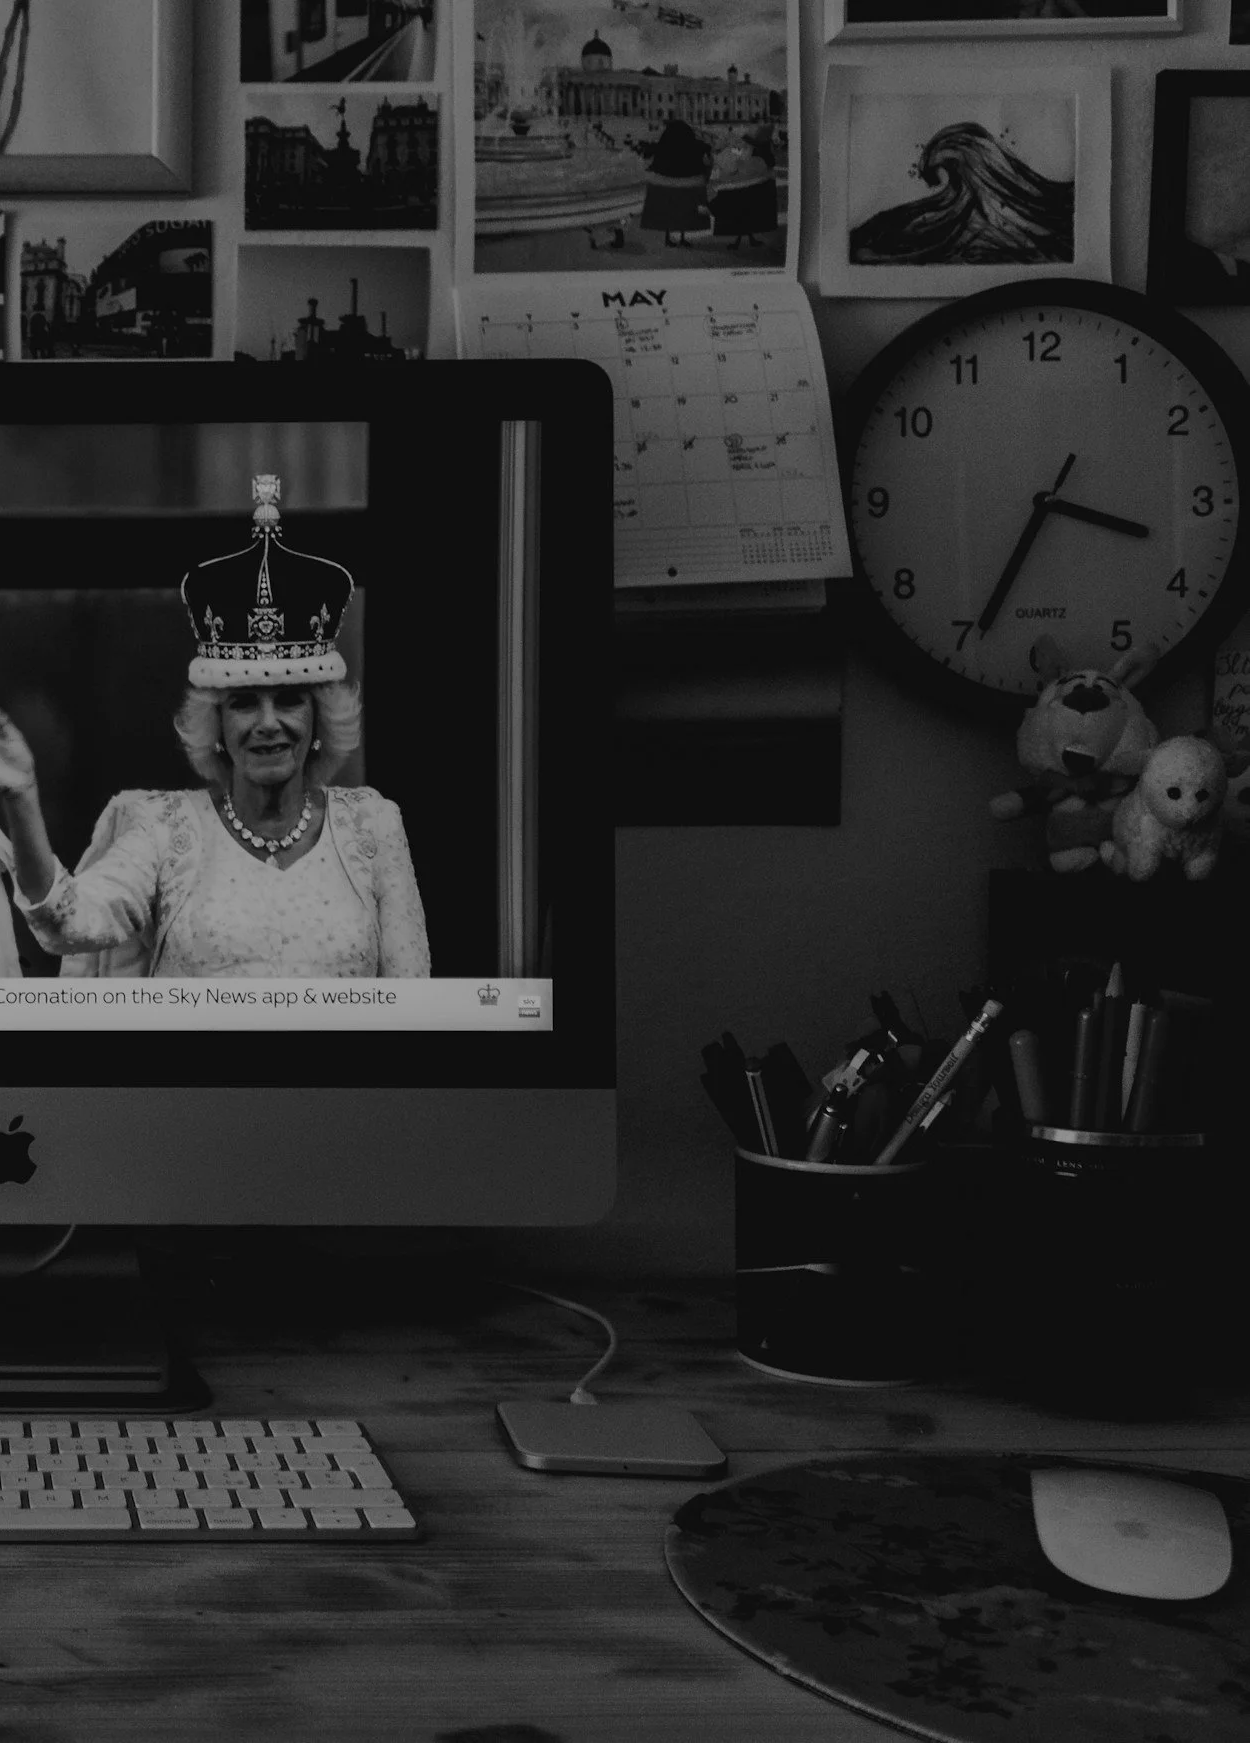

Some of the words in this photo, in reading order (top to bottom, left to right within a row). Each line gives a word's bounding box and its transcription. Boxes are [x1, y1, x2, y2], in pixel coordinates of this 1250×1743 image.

[602, 289, 667, 308] MAY
[1023, 331, 1061, 362] 12
[950, 353, 978, 386] 11
[1114, 354, 1128, 385] 1
[894, 405, 933, 438] 10
[1167, 405, 1190, 437] 2
[867, 486, 890, 519] 9
[1192, 485, 1215, 518] 3
[892, 568, 916, 601] 8
[1166, 568, 1190, 599] 4
[1015, 607, 1067, 620] QUARTZ
[951, 620, 974, 652] 7
[1111, 620, 1133, 652] 5
[103, 992, 126, 1004] on
[132, 988, 163, 1004] the
[169, 988, 200, 1008] Sky
[207, 988, 256, 1004] News
[262, 992, 298, 1008] app
[304, 988, 317, 1004] &
[322, 988, 396, 1004] website
